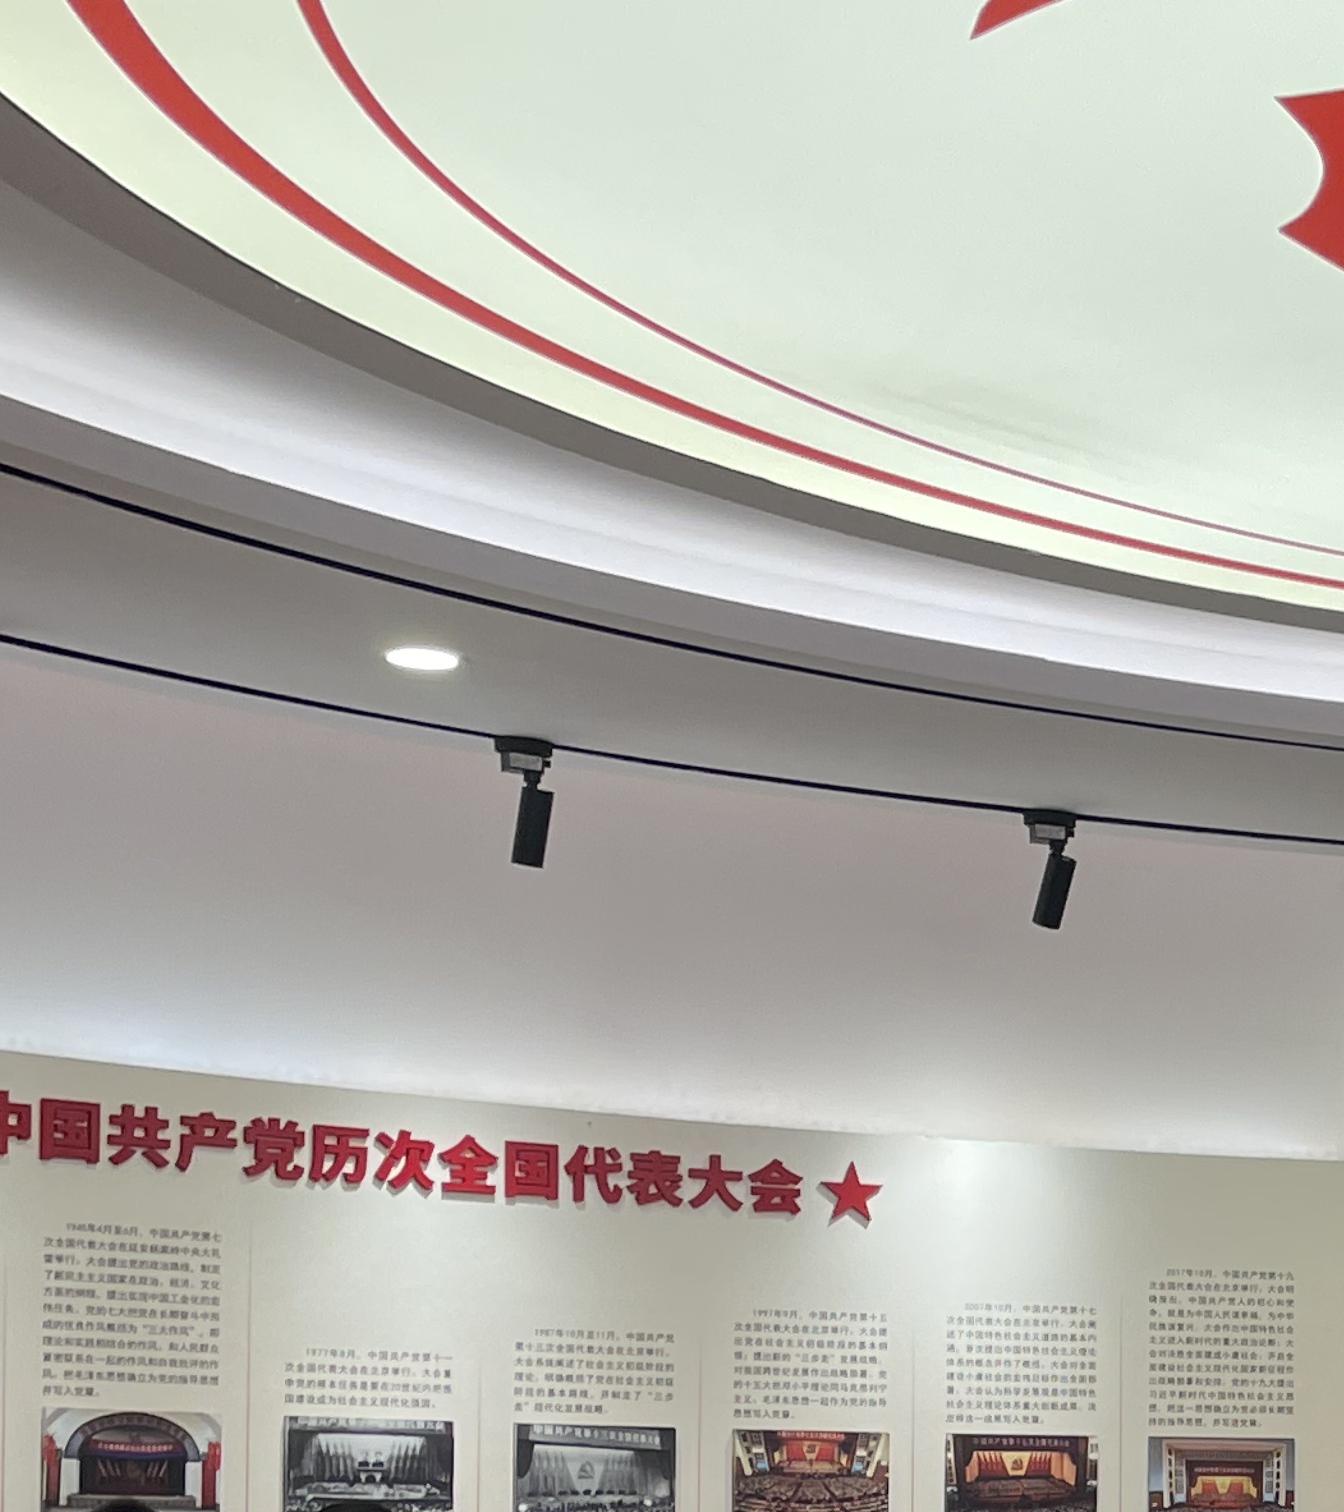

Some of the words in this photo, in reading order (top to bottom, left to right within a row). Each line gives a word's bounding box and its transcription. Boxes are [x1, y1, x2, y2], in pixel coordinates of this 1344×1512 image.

[0, 1090, 804, 1217] 中国共产党历次全国代表大会
